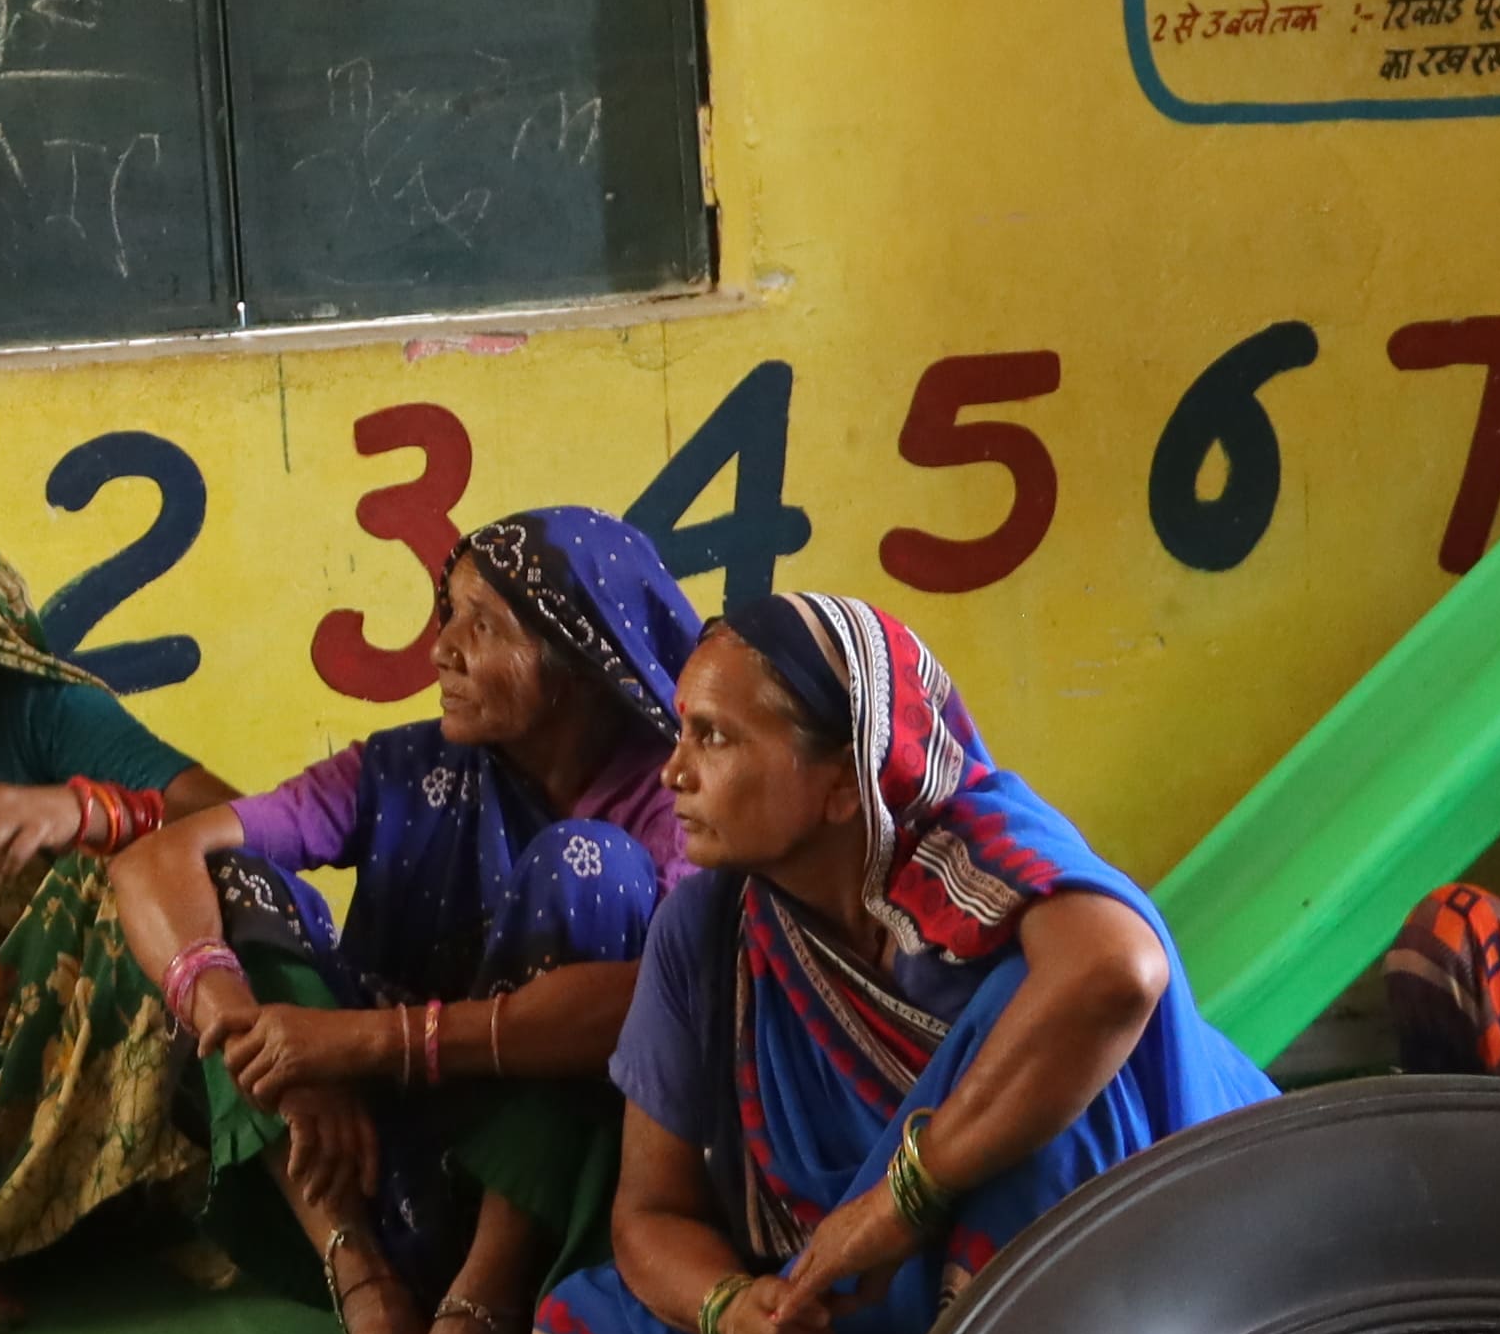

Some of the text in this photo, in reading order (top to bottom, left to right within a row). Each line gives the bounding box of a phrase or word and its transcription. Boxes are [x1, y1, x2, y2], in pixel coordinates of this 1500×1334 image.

[1153, 14, 1167, 42] 2
[1174, 1, 1201, 44] से
[1202, 11, 1228, 39] 3
[1270, 4, 1323, 35] तक
[40, 430, 207, 695] 2
[311, 403, 471, 703] 3
[622, 360, 812, 618] 4
[878, 349, 1060, 593] 5
[1149, 321, 1318, 572] 6
